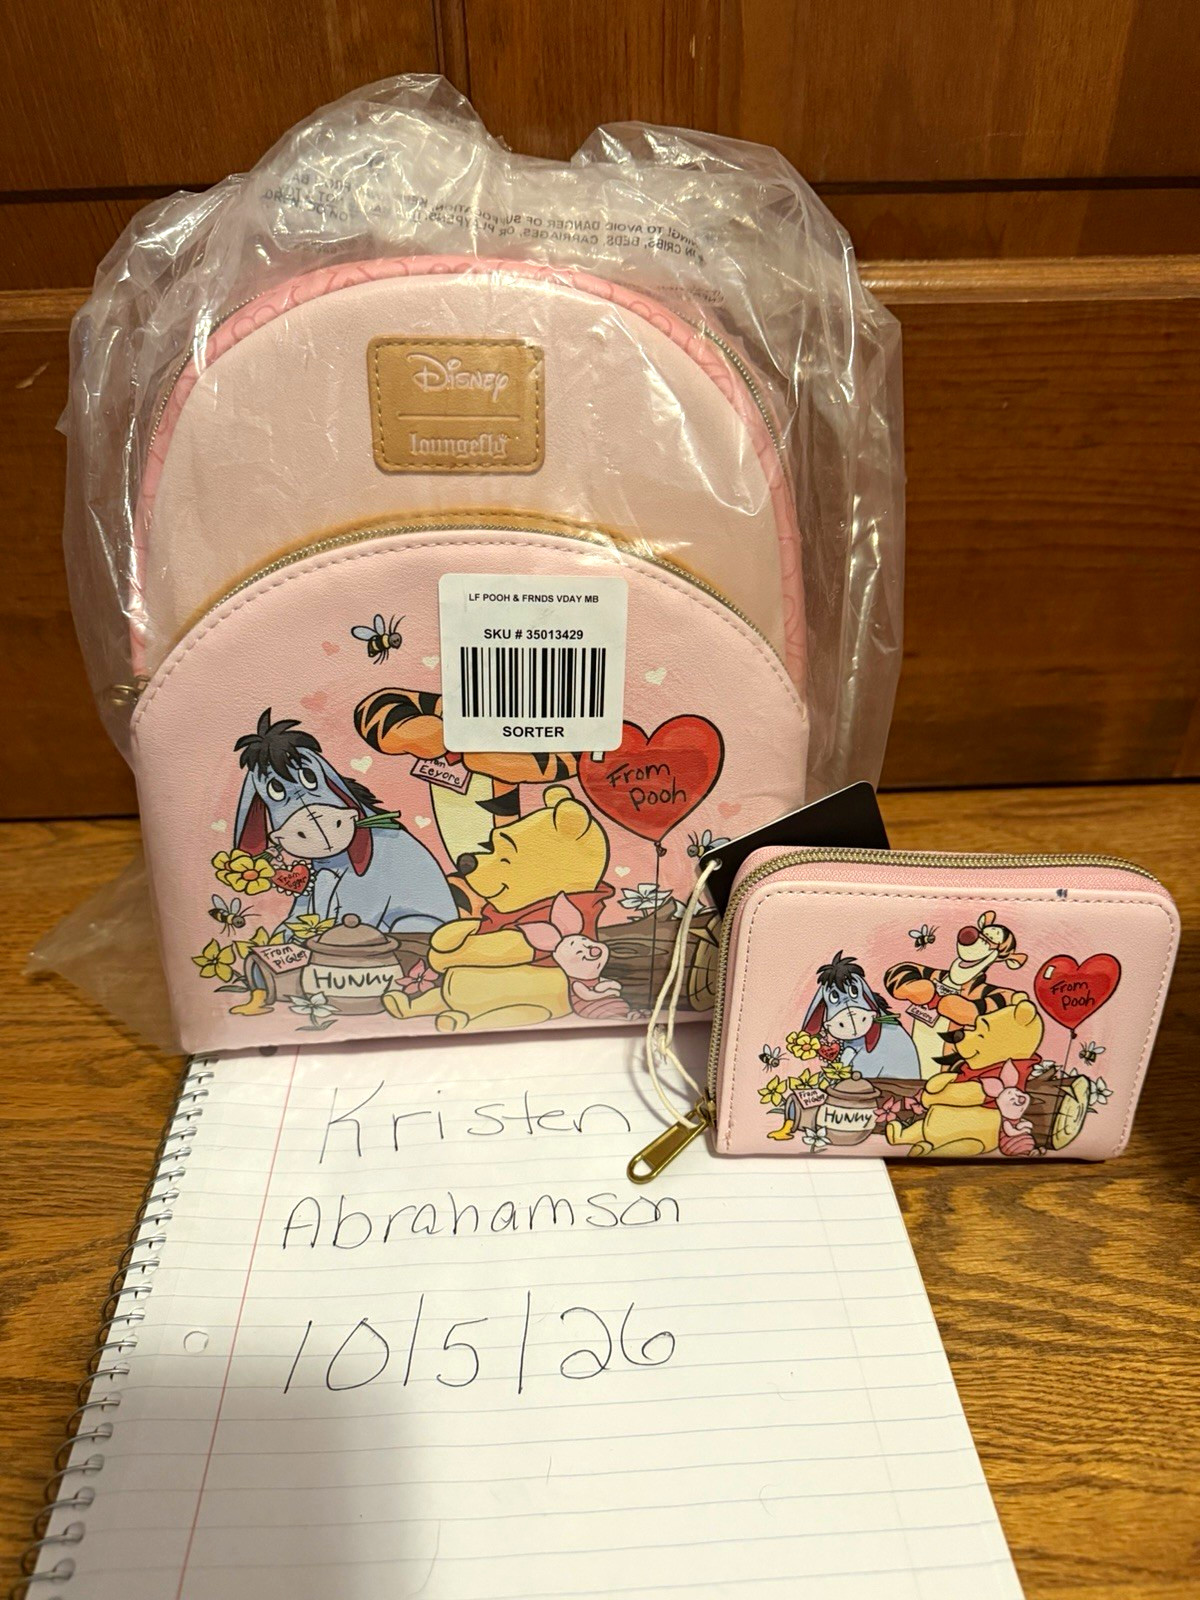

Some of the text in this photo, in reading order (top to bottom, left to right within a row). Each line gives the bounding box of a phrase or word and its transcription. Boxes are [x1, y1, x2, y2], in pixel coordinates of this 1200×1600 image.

[406, 352, 510, 404] Disney
[468, 593, 600, 603] LF POOH & FRNDS VDAY MB
[483, 629, 584, 640] SKU # 35013429
[502, 726, 565, 738] SORTER
[419, 764, 460, 785] Eeyore
[606, 763, 670, 787] From
[260, 946, 293, 960] From
[1050, 980, 1089, 995] From
[319, 1080, 632, 1164] Kristen
[282, 1192, 680, 1250] Abrahamson
[284, 1290, 676, 1395] 10/5/26
